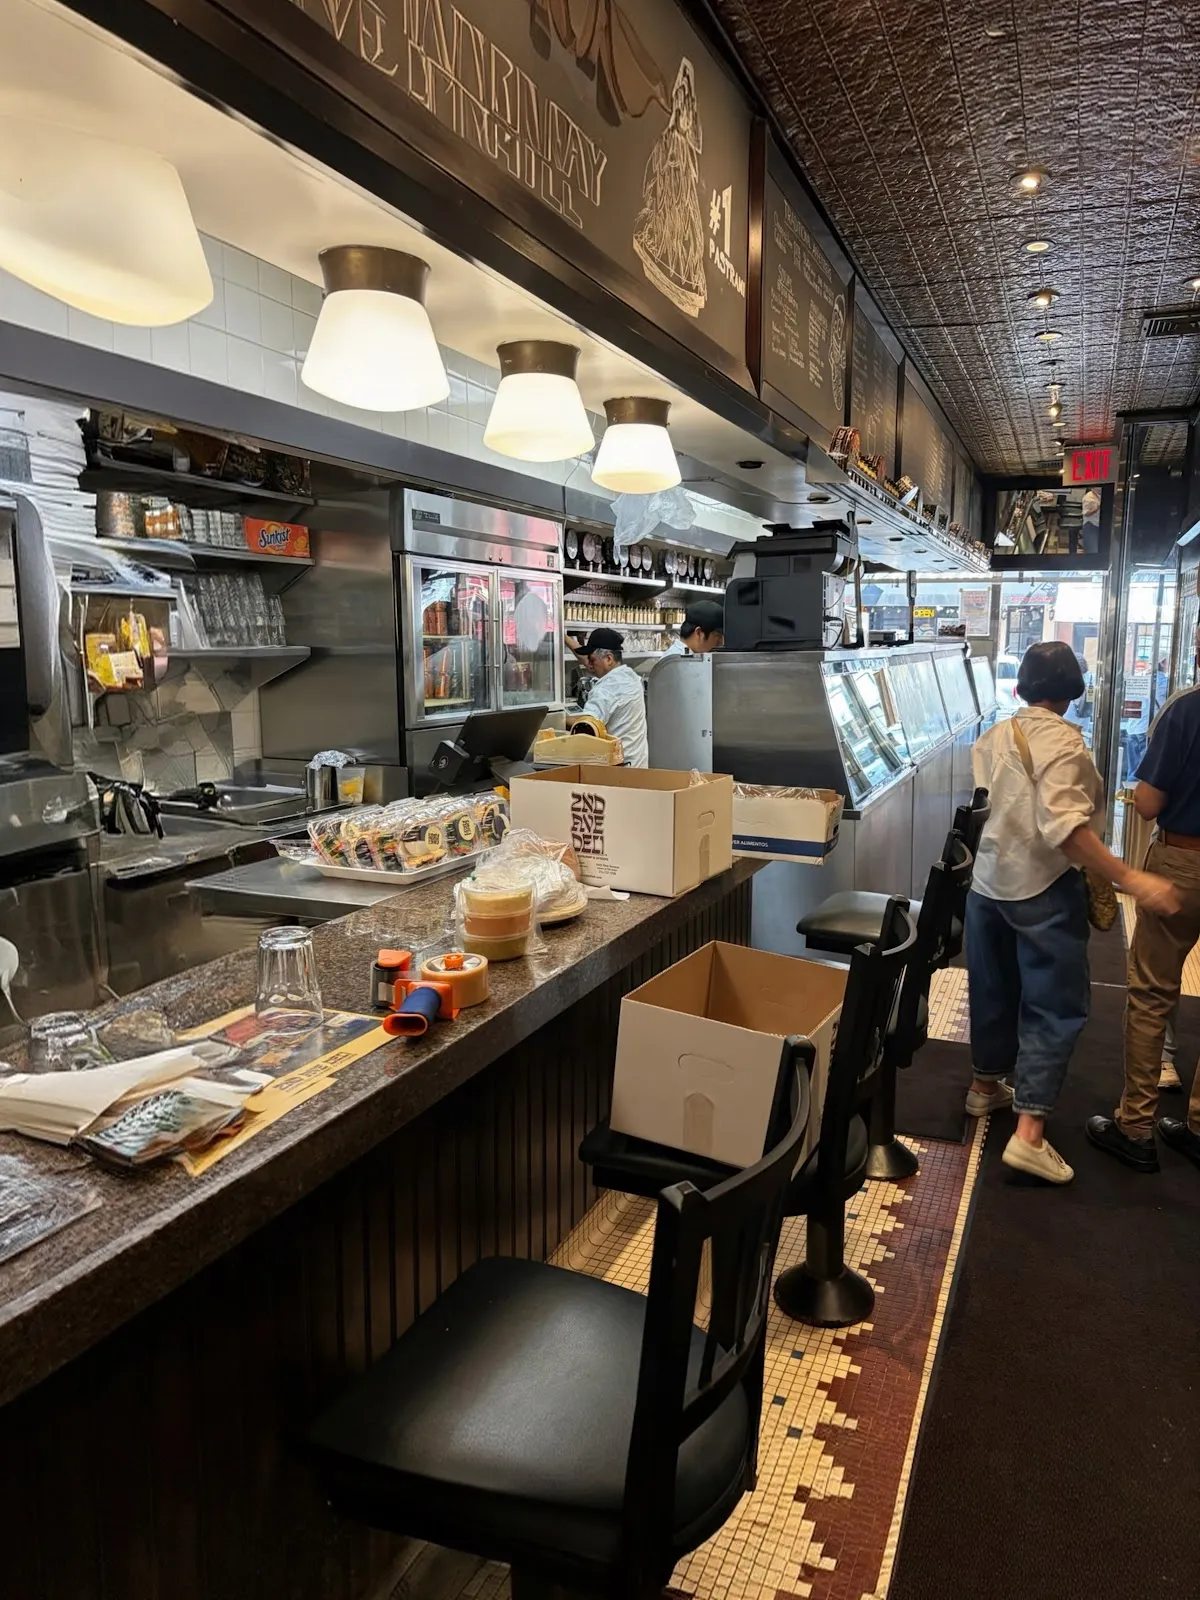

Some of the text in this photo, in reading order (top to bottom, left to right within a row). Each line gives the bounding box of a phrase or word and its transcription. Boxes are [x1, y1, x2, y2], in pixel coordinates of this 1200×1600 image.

[709, 184, 733, 258] #1
[1072, 449, 1112, 481] EXIT
[259, 527, 292, 549] Sunkist
[571, 792, 606, 814] 2ND
[571, 813, 605, 835] AVE
[572, 833, 605, 855] DELI
[740, 840, 769, 848] ALIMENTOS
